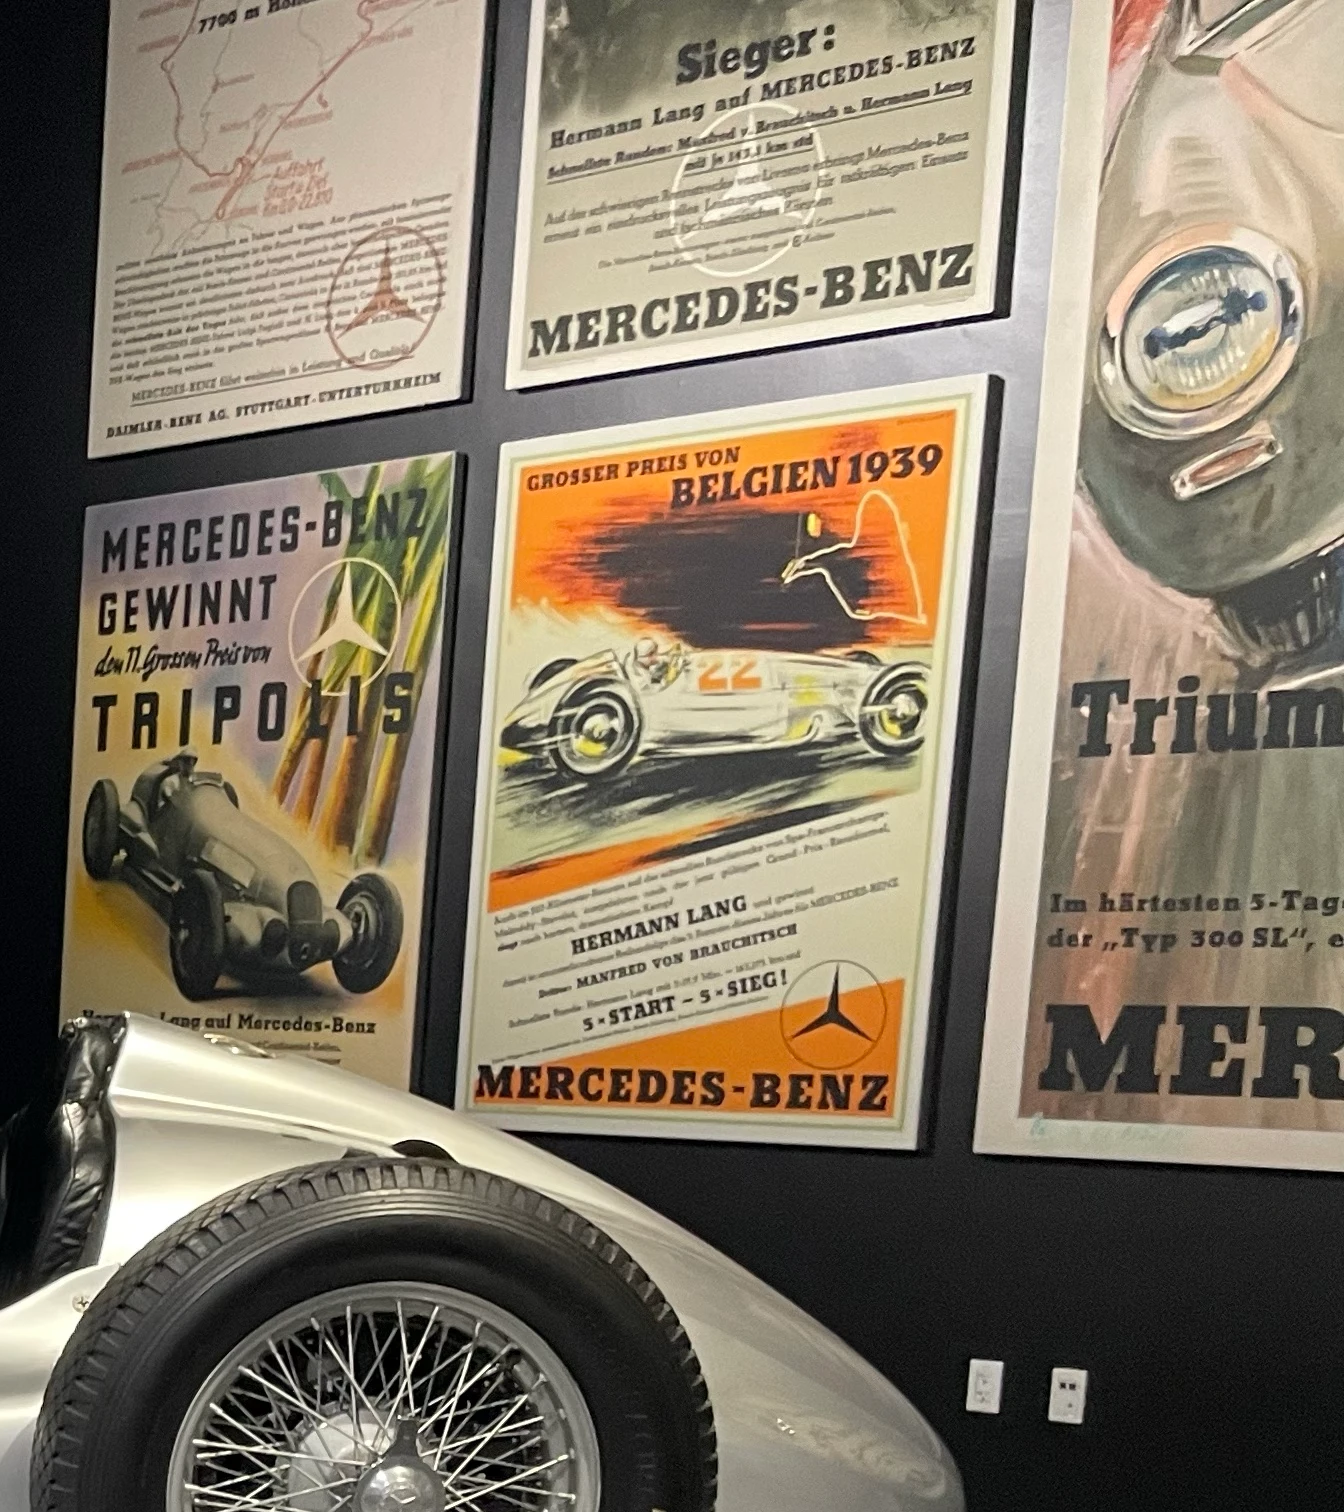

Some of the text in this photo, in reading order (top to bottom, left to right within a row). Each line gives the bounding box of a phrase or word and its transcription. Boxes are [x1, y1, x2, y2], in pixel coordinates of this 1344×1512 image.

[676, 24, 836, 85] Sieger:
[549, 36, 976, 149] Hermann Lang auf MERCEDES-BENZ
[934, 79, 973, 97] Lang
[528, 244, 974, 358] MERCEDES-BENZ
[526, 446, 741, 491] GROSSER PREIS VON
[671, 443, 943, 509] BELGIEN 1939
[102, 487, 427, 573] MERCEDES-BENZ
[98, 575, 277, 635] GEWINNT
[203, 637, 241, 666] Preis
[242, 645, 272, 664] von
[697, 659, 763, 692] 22
[92, 671, 415, 752] TRIPOLIS
[571, 913, 679, 955] HERMANN
[686, 895, 747, 926] LANG
[1050, 889, 1344, 916] Im härtesten 5-Tag
[576, 961, 647, 989] MANFRED
[651, 952, 684, 969] VON
[690, 923, 798, 961] BRAUCHITSCH
[1047, 928, 1093, 948] der
[1190, 929, 1244, 948] 300
[238, 1013, 377, 1034] Mercedes-Benz
[475, 1063, 890, 1112] MERCEDES-BENZ
